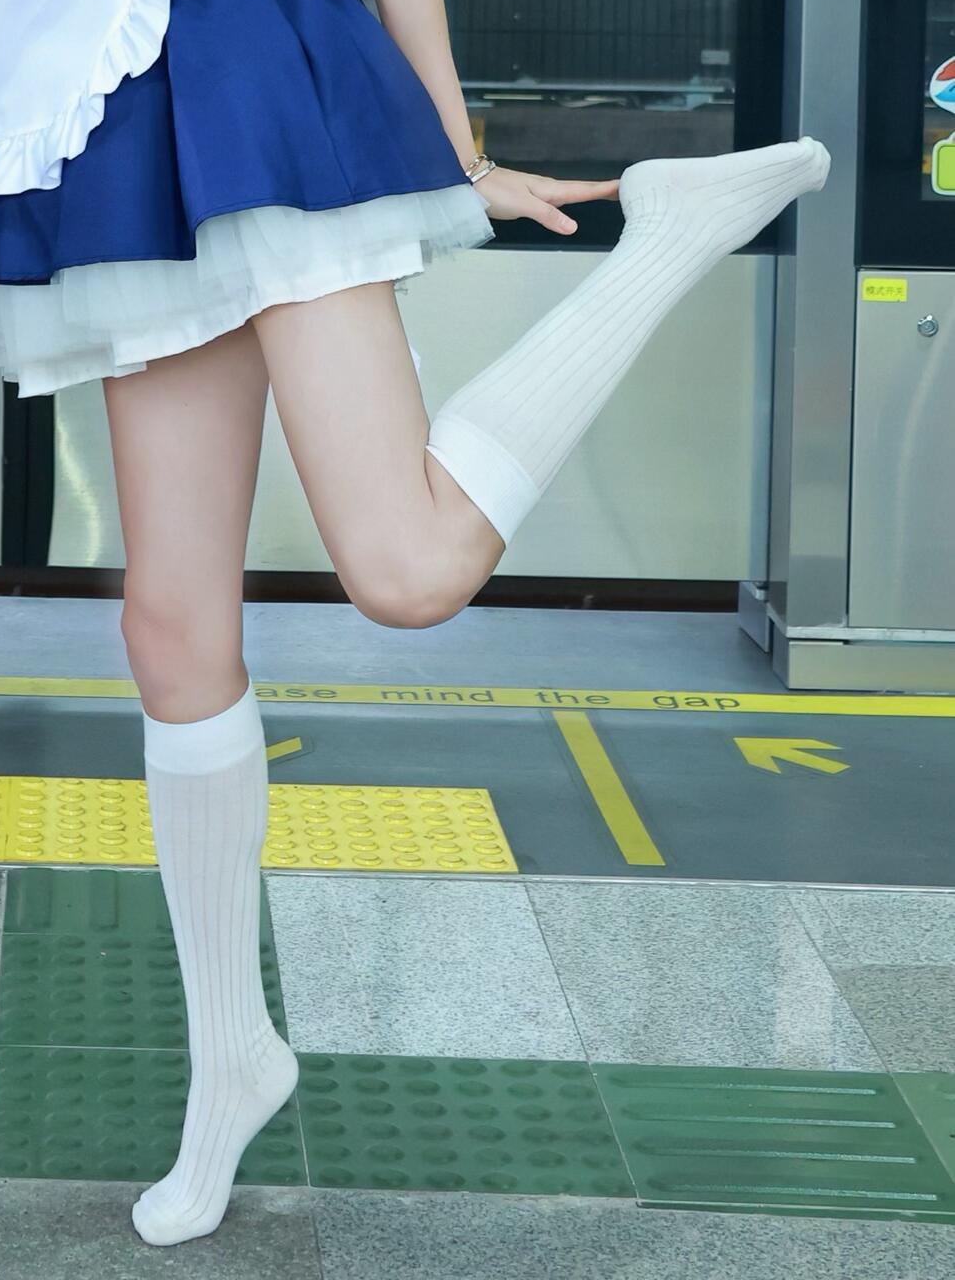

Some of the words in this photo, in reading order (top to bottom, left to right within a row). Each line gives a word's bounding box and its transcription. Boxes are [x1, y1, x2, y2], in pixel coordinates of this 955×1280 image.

[255, 688, 338, 699] ase
[381, 687, 494, 704] mind
[535, 690, 611, 708] the
[652, 694, 740, 711] gap
